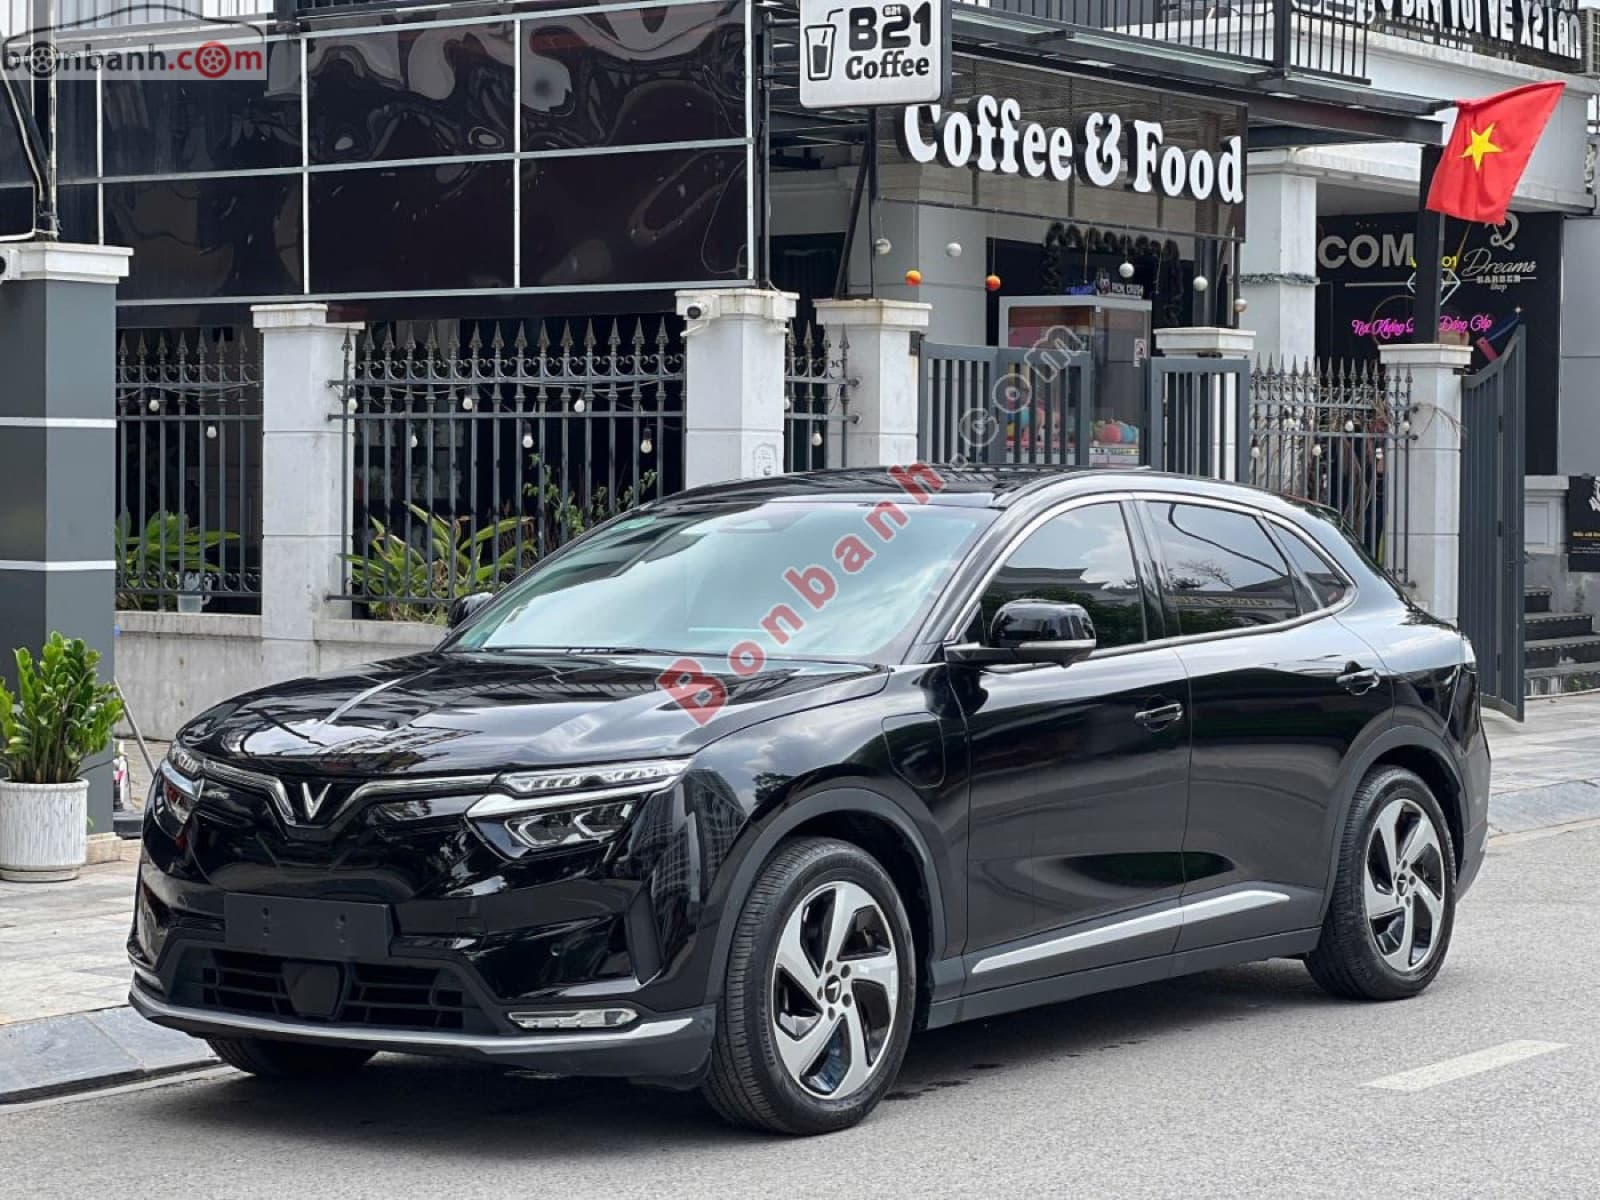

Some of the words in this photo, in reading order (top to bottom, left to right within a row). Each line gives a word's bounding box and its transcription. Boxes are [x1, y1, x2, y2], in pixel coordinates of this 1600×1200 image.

[849, 1, 931, 51] B21
[845, 50, 930, 80] Coffee
[904, 95, 1073, 182] Coffee
[1084, 112, 1122, 187] &
[1132, 119, 1244, 204] Food
[1461, 248, 1537, 277] Dreams
